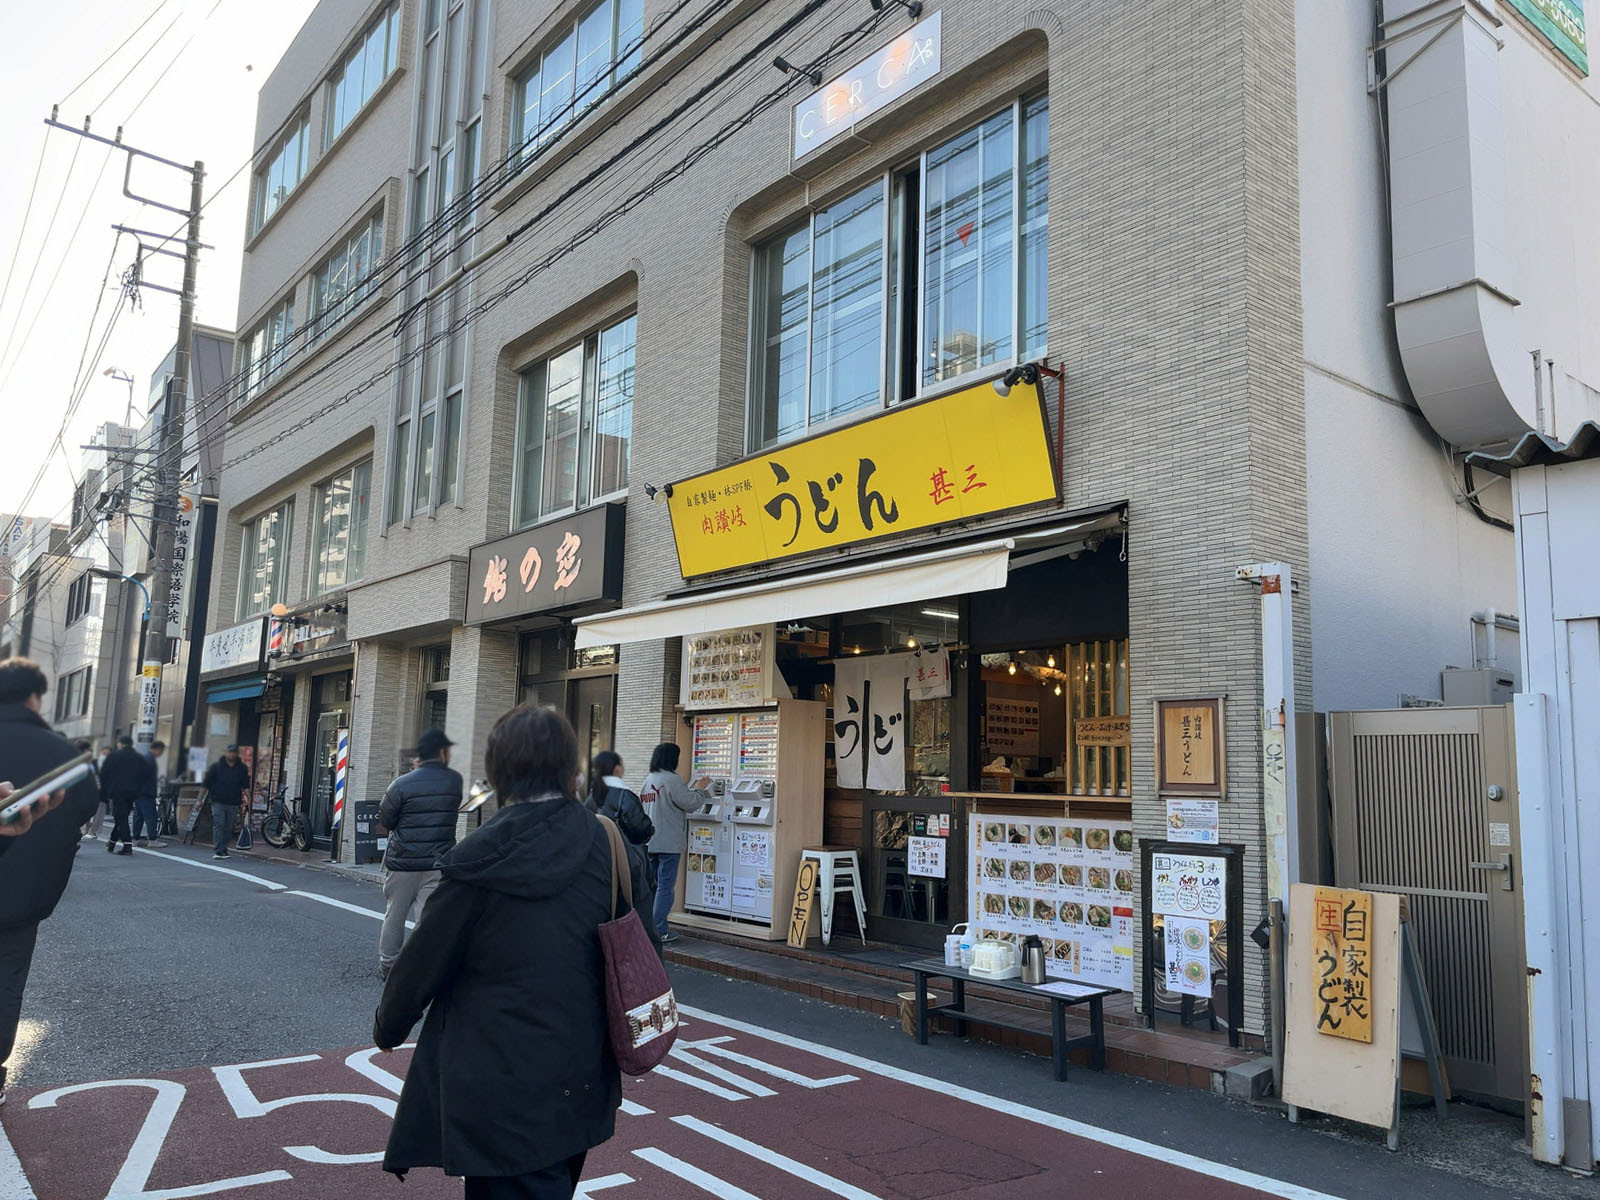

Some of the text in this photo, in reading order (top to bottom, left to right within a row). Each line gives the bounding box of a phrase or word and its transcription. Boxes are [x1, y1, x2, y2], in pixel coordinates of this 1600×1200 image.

[763, 457, 988, 548] うどん 甚三
[1180, 714, 1193, 777] 甚三うどん
[790, 863, 814, 946] OPEN
[1316, 950, 1342, 1030] うどん
[1340, 899, 1369, 1020] 自家製
